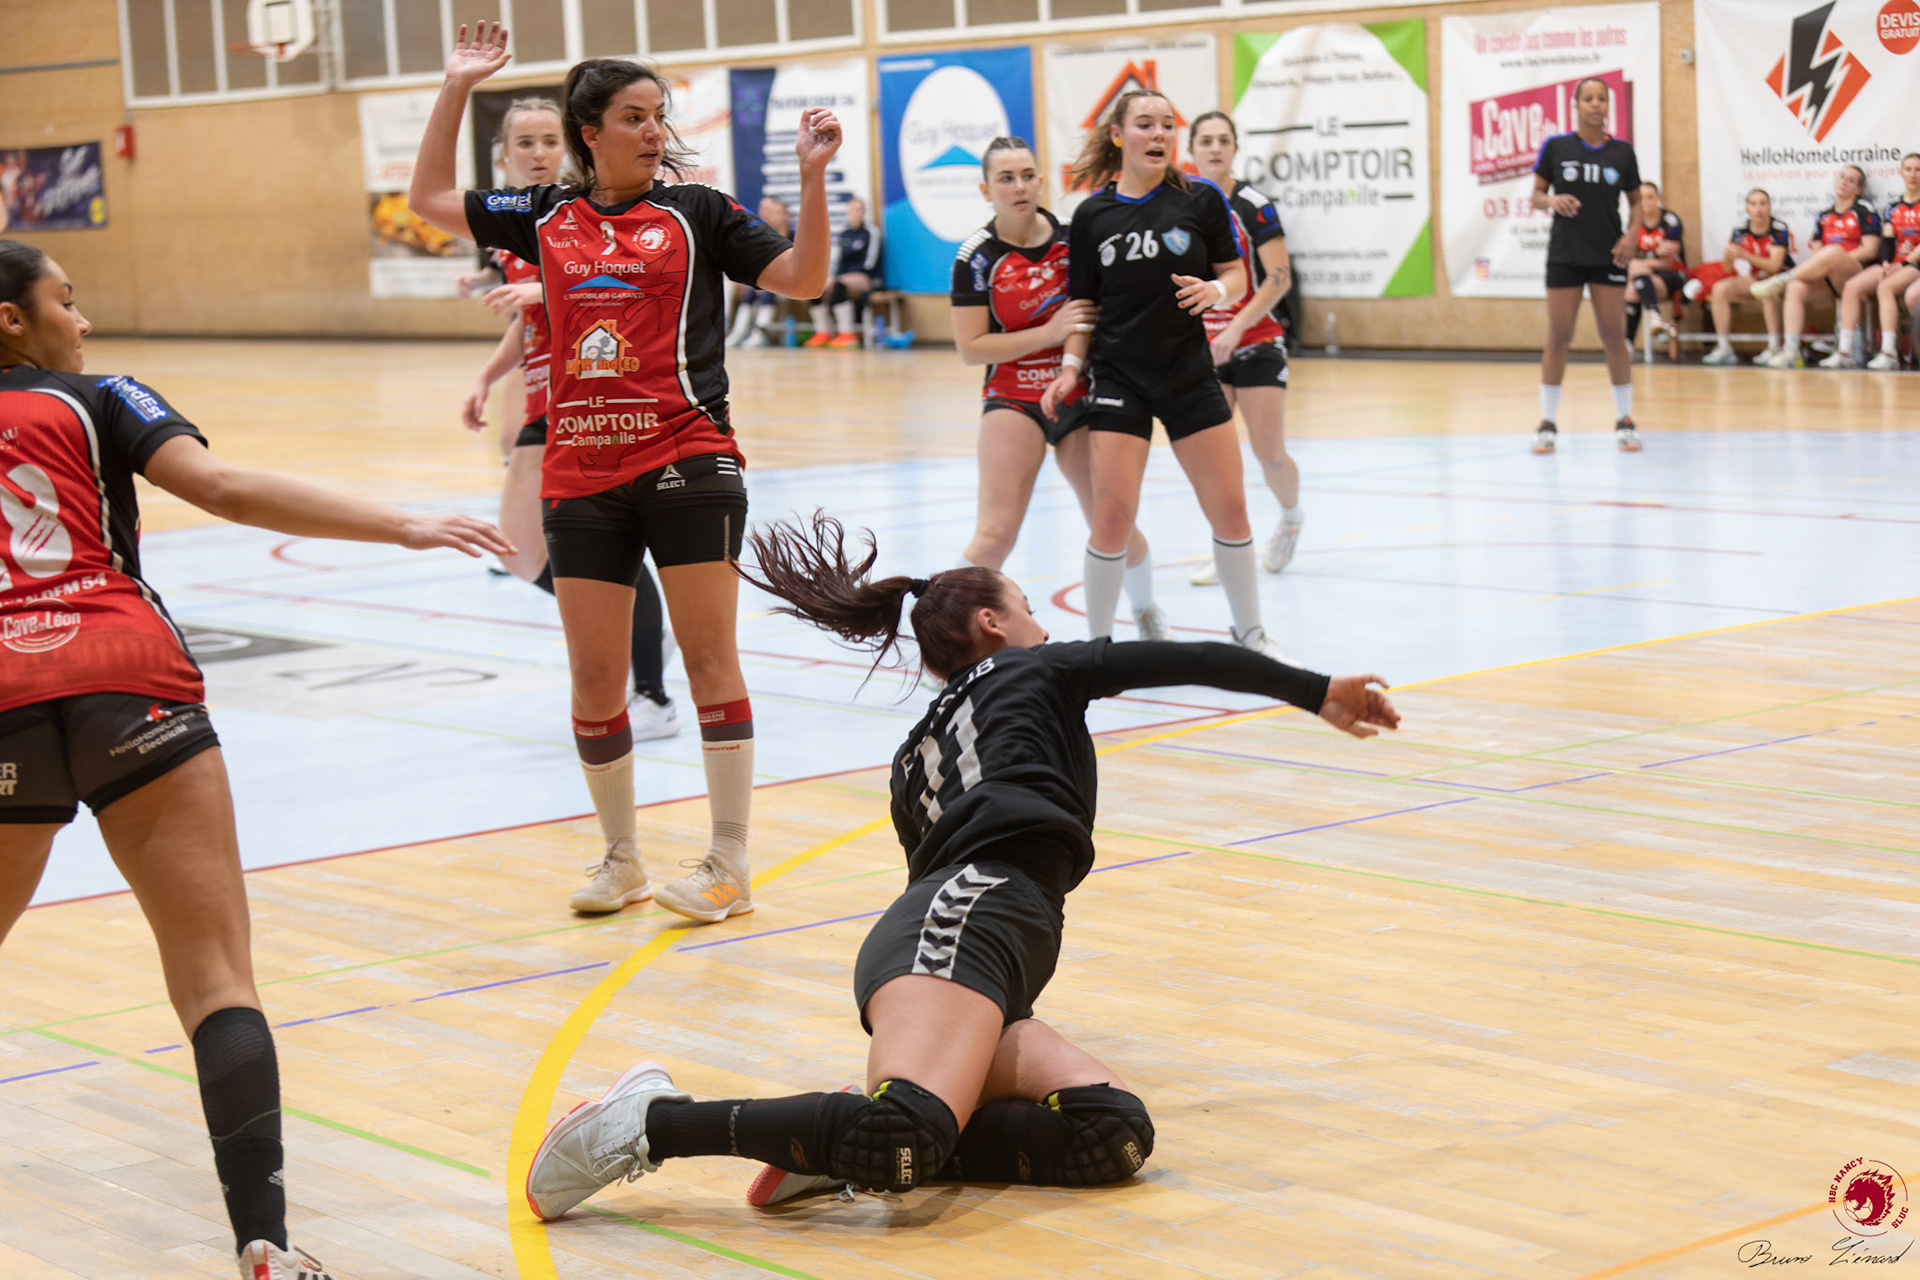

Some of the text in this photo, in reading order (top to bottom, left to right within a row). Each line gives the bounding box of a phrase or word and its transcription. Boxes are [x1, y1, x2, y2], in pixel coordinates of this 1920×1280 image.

[1880, 12, 1920, 28] DEVIS
[1880, 28, 1919, 39] GRATUIT
[1316, 117, 1340, 137] LE
[1481, 98, 1544, 159] Cave
[1740, 143, 1901, 166] HelloHomeLorraine
[1244, 148, 1415, 186] COMPTOIR
[1583, 163, 1600, 184] 11
[1281, 184, 1379, 213] Campanile
[600, 221, 617, 256] 9
[1126, 229, 1159, 262] 26
[564, 260, 647, 277] Guy Hoquet
[588, 396, 605, 408] LE
[556, 412, 660, 434] COMPTOIR
[571, 432, 637, 449] Campanile
[656, 479, 687, 491] SELECT
[82, 572, 107, 590] 54
[3, 615, 38, 640] Cave
[45, 611, 81, 629] Léon
